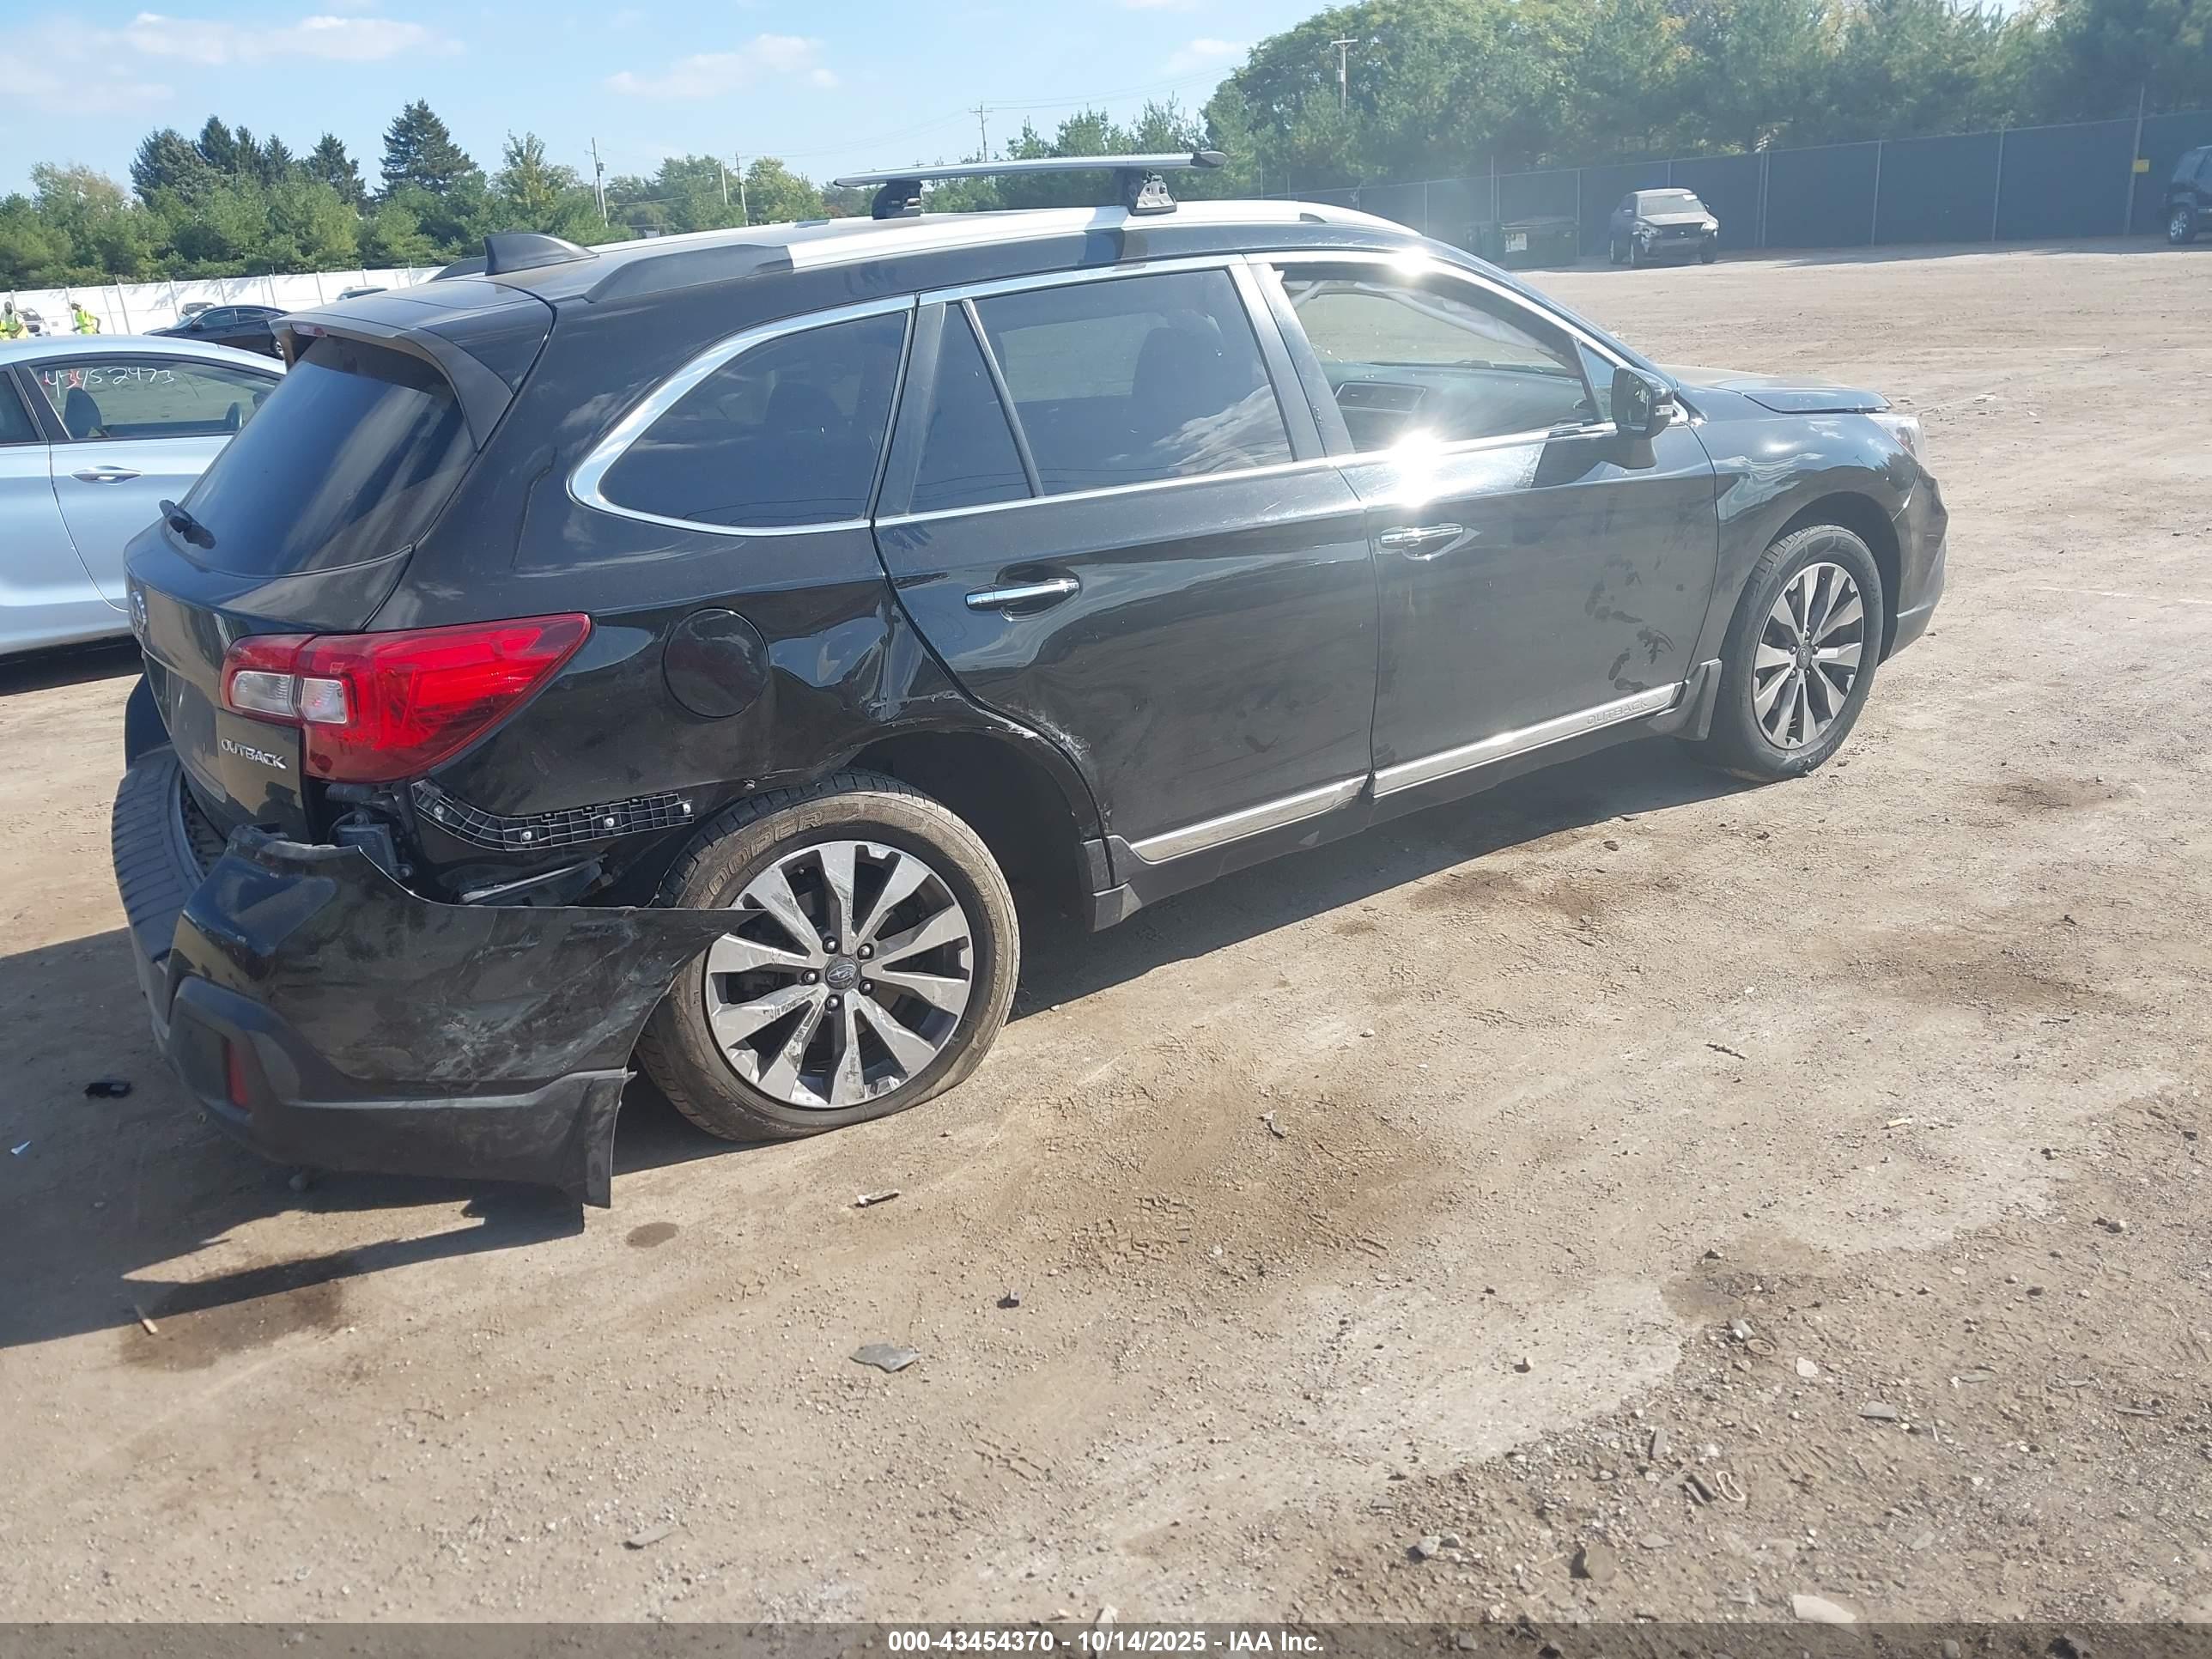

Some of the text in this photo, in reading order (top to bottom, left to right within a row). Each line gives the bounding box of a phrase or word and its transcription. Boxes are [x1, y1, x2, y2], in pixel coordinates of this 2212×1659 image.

[44, 368, 176, 399] 43452473
[221, 738, 288, 769] OUTBACK
[694, 811, 823, 909] COOPER
